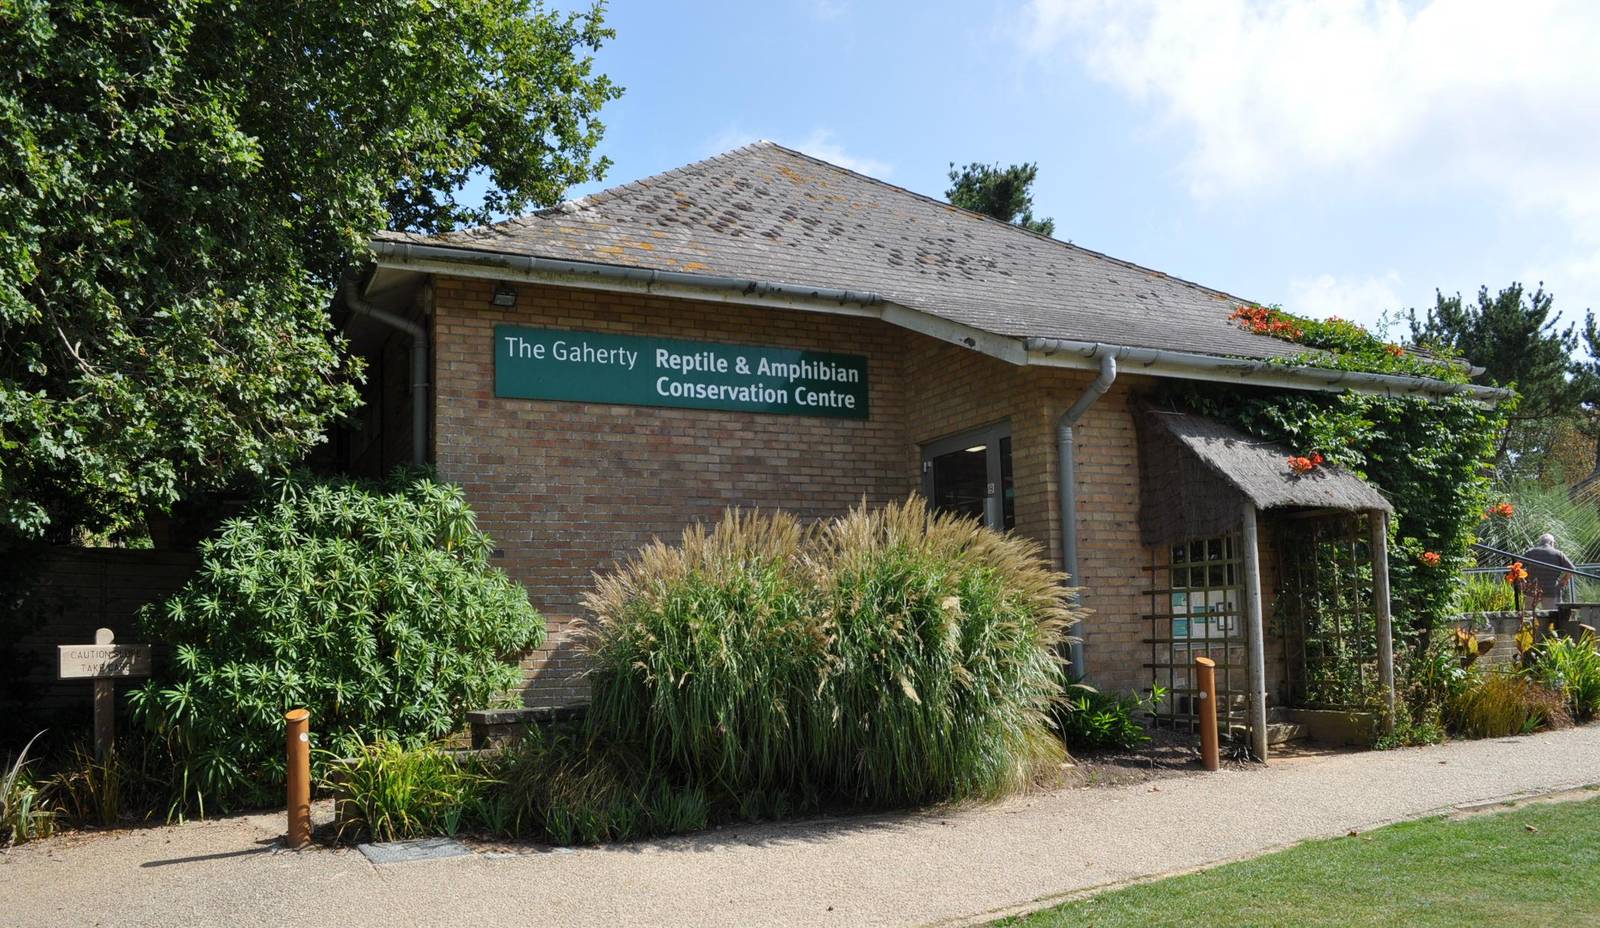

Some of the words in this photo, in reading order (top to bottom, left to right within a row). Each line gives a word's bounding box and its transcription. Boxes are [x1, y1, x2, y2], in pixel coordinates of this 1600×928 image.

[504, 336, 546, 360] The
[552, 340, 638, 370] Gaherty
[655, 348, 728, 375] Reptile
[735, 356, 751, 375] &
[757, 357, 859, 384] Amphibian
[656, 376, 788, 404] Conservation
[794, 386, 856, 409] Centre
[70, 650, 111, 660] CAUTION
[81, 663, 105, 672] TAKE
